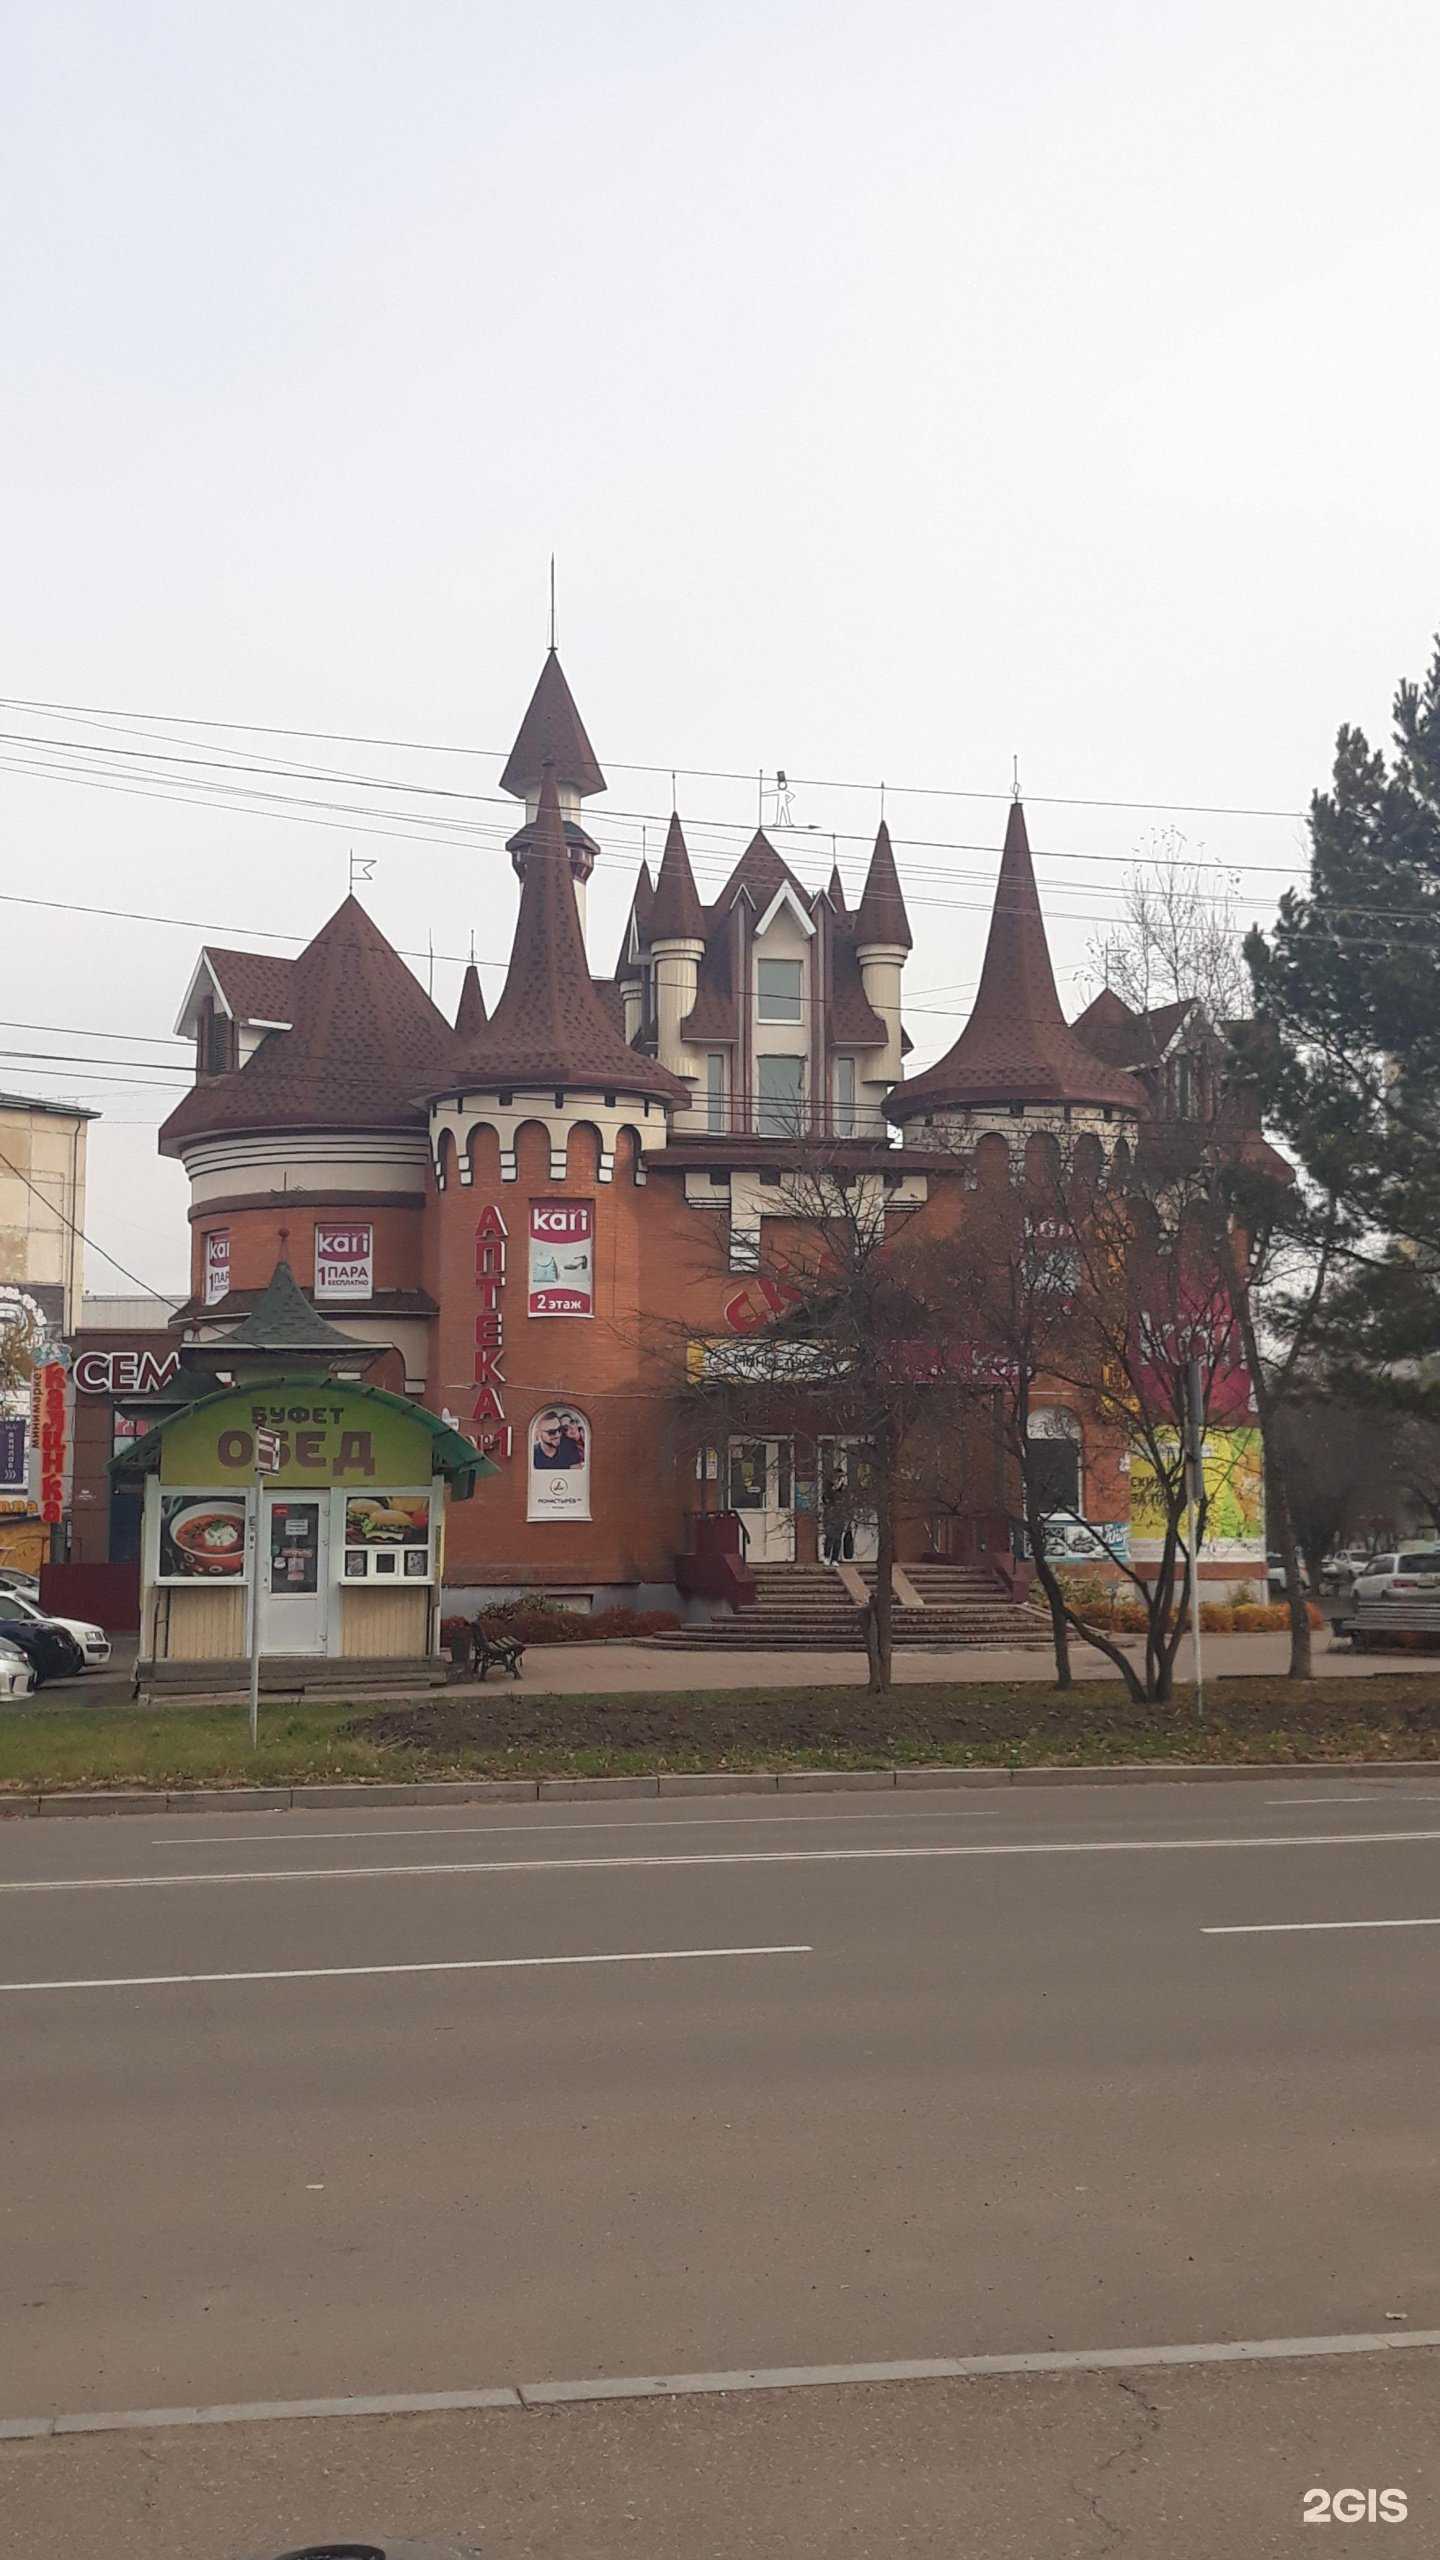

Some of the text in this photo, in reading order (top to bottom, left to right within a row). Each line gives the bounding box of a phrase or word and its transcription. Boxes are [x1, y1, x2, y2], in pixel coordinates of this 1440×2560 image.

[533, 1208, 588, 1231] kari
[318, 1232, 369, 1253] kari
[318, 1267, 369, 1286] 1 ПАРА
[537, 1295, 581, 1310] 2 этаж
[474, 1205, 508, 1421] АПТЕКА
[251, 1406, 344, 1425] БУФЕТ
